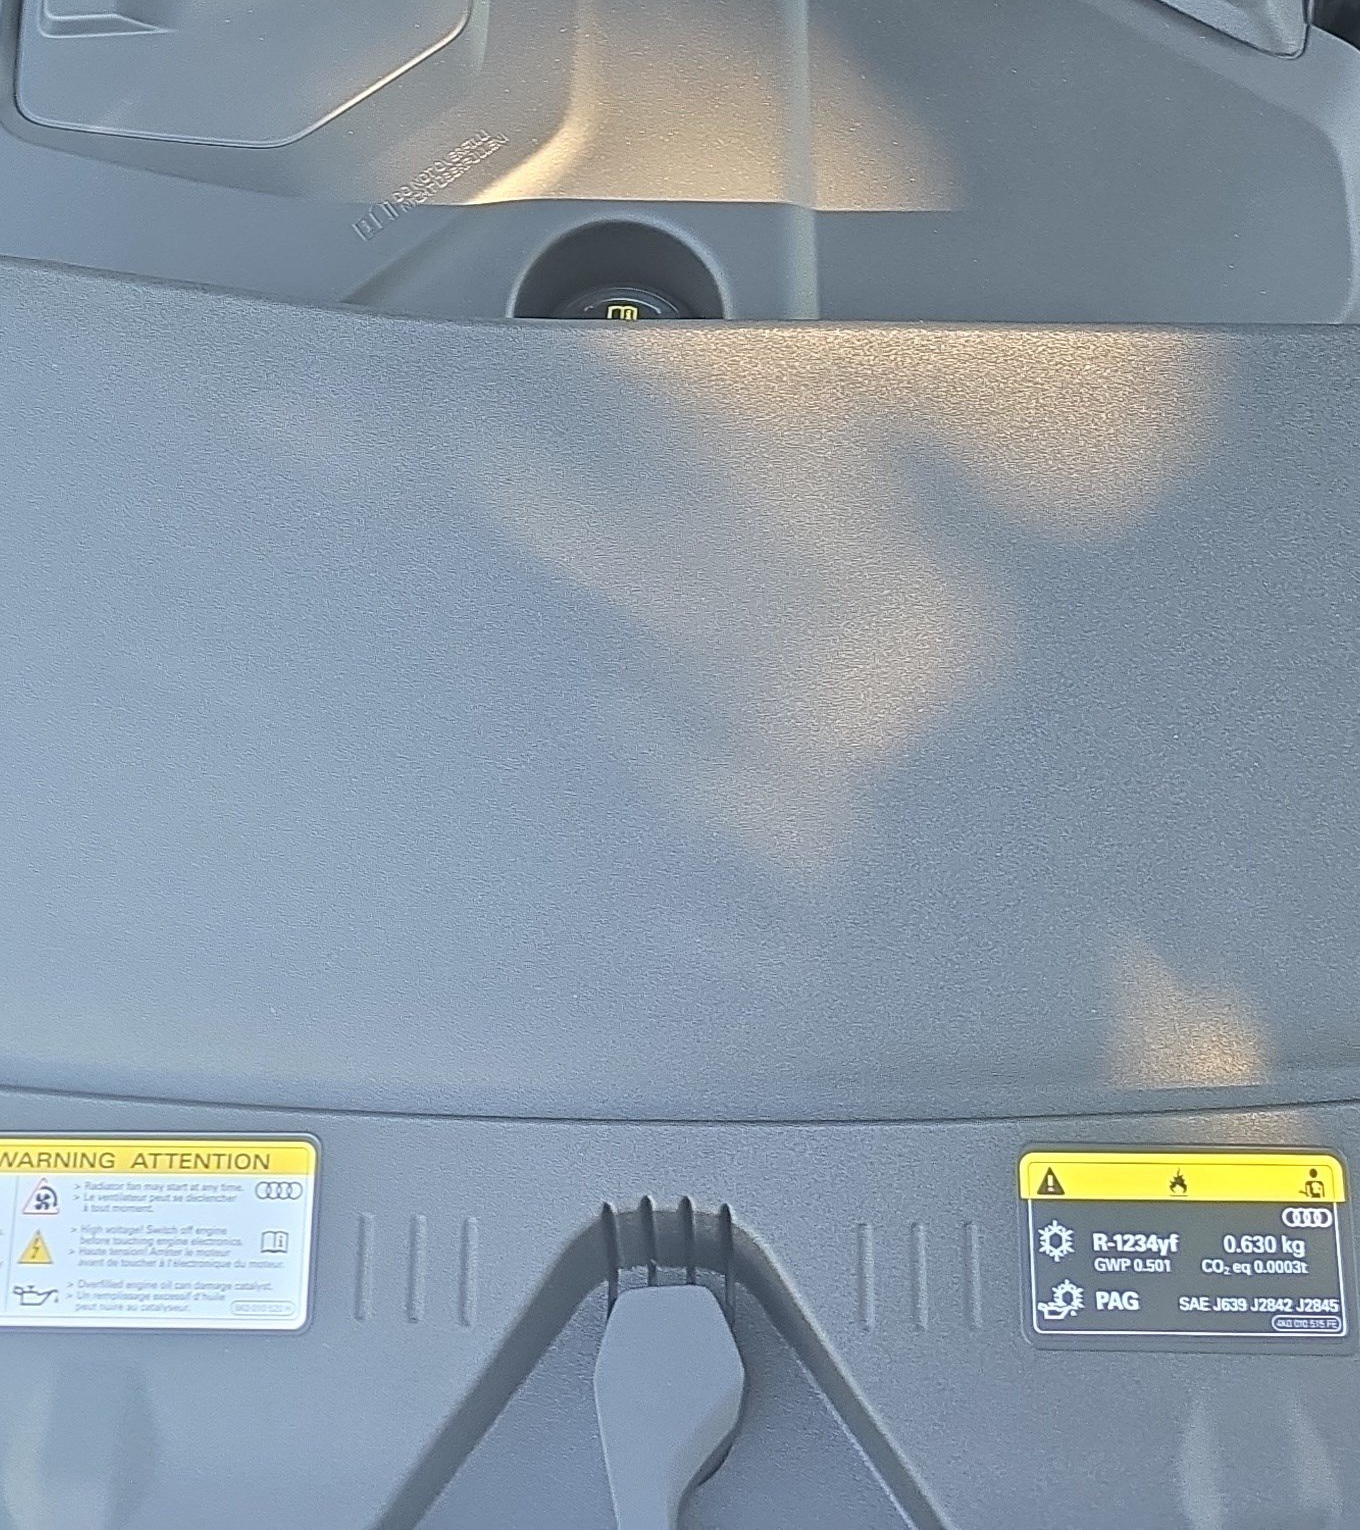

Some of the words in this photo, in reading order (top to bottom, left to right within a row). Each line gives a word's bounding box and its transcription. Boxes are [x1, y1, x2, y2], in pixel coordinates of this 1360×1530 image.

[392, 186, 413, 203] DO
[409, 168, 435, 190] NOT
[130, 1153, 270, 1170] ATTENTION
[1092, 1233, 1181, 1257] R-1234yf
[1223, 1236, 1277, 1254] 0.630
[1282, 1236, 1306, 1258] kg
[1094, 1258, 1131, 1273] GWP
[1134, 1259, 1172, 1273] 0.501
[1232, 1262, 1252, 1276] eq
[1253, 1260, 1309, 1274] 0.0003t
[1095, 1292, 1140, 1311] PAG
[1179, 1297, 1211, 1311] SAE
[1213, 1297, 1247, 1312] J639
[1250, 1298, 1293, 1312] J2842
[1296, 1298, 1339, 1313] J2845
